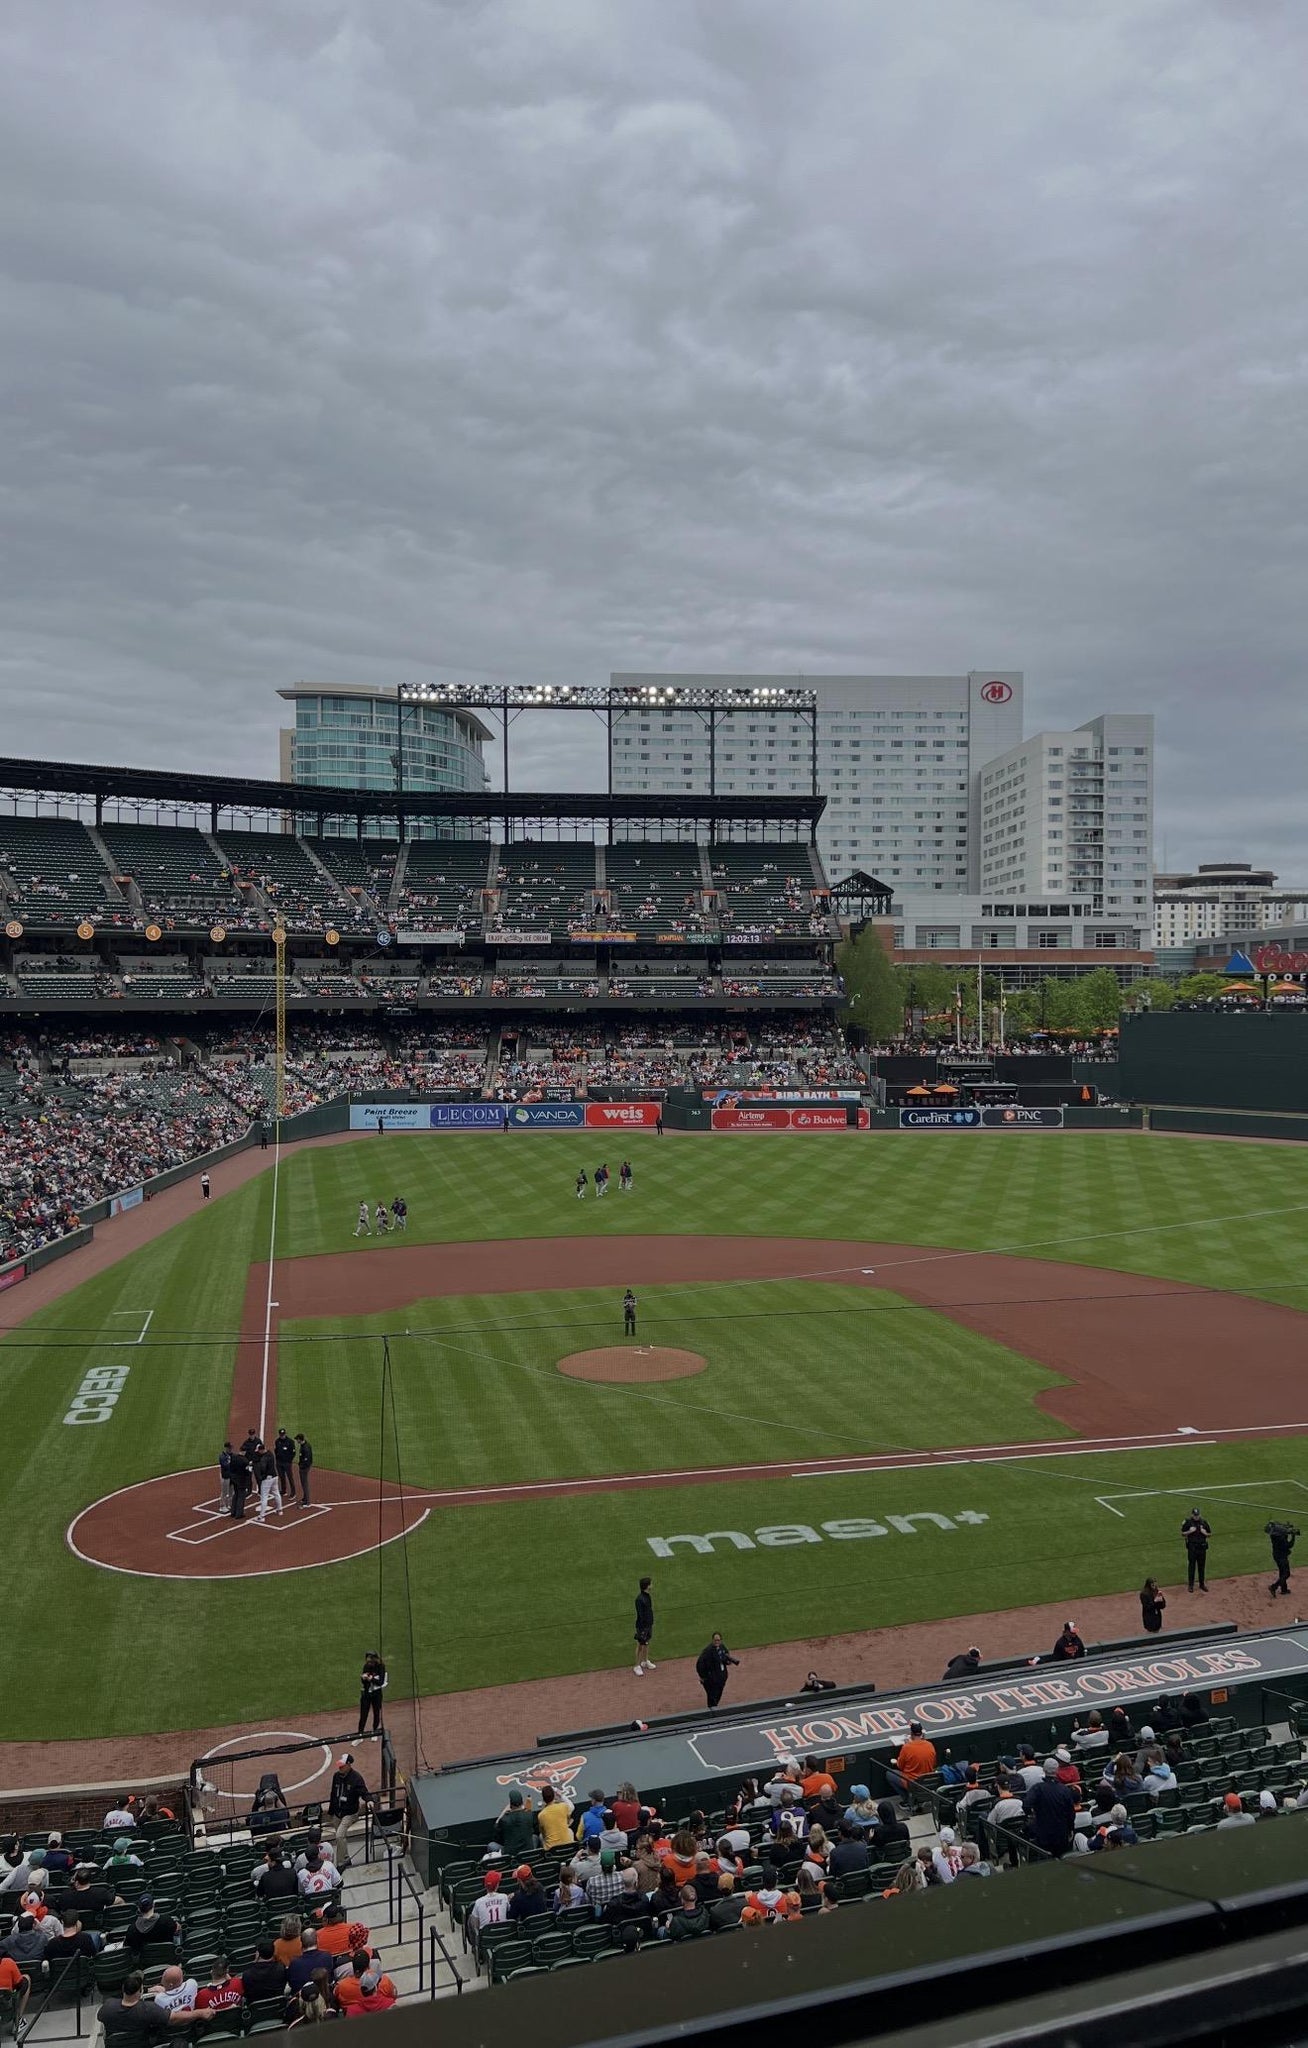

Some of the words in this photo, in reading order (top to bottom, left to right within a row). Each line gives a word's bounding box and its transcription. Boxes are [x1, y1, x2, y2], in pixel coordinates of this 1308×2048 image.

[9, 925, 21, 936] 20
[82, 926, 90, 937] 5
[150, 928, 157, 938] 4
[212, 930, 224, 939] 22
[378, 933, 389, 944] 42
[726, 934, 760, 943] 12:02:13
[1254, 973, 1307, 982] ROOF
[776, 1090, 801, 1100] BIRD
[803, 1090, 830, 1100] BATH
[437, 1109, 500, 1120] LECOM
[530, 1110, 578, 1119] VANDA
[602, 1106, 644, 1119] weis
[739, 1111, 765, 1120] Airtemp
[908, 1112, 953, 1124] CareFirst
[1017, 1110, 1042, 1120] PNC
[62, 1365, 131, 1425] GEICO
[759, 1707, 912, 1752] HOME
[913, 1698, 977, 1723] OF
[975, 1679, 1084, 1713] THE
[1076, 1649, 1262, 1695] ORIOLES
[313, 1879, 324, 1892] 2
[488, 1907, 500, 1923] 11
